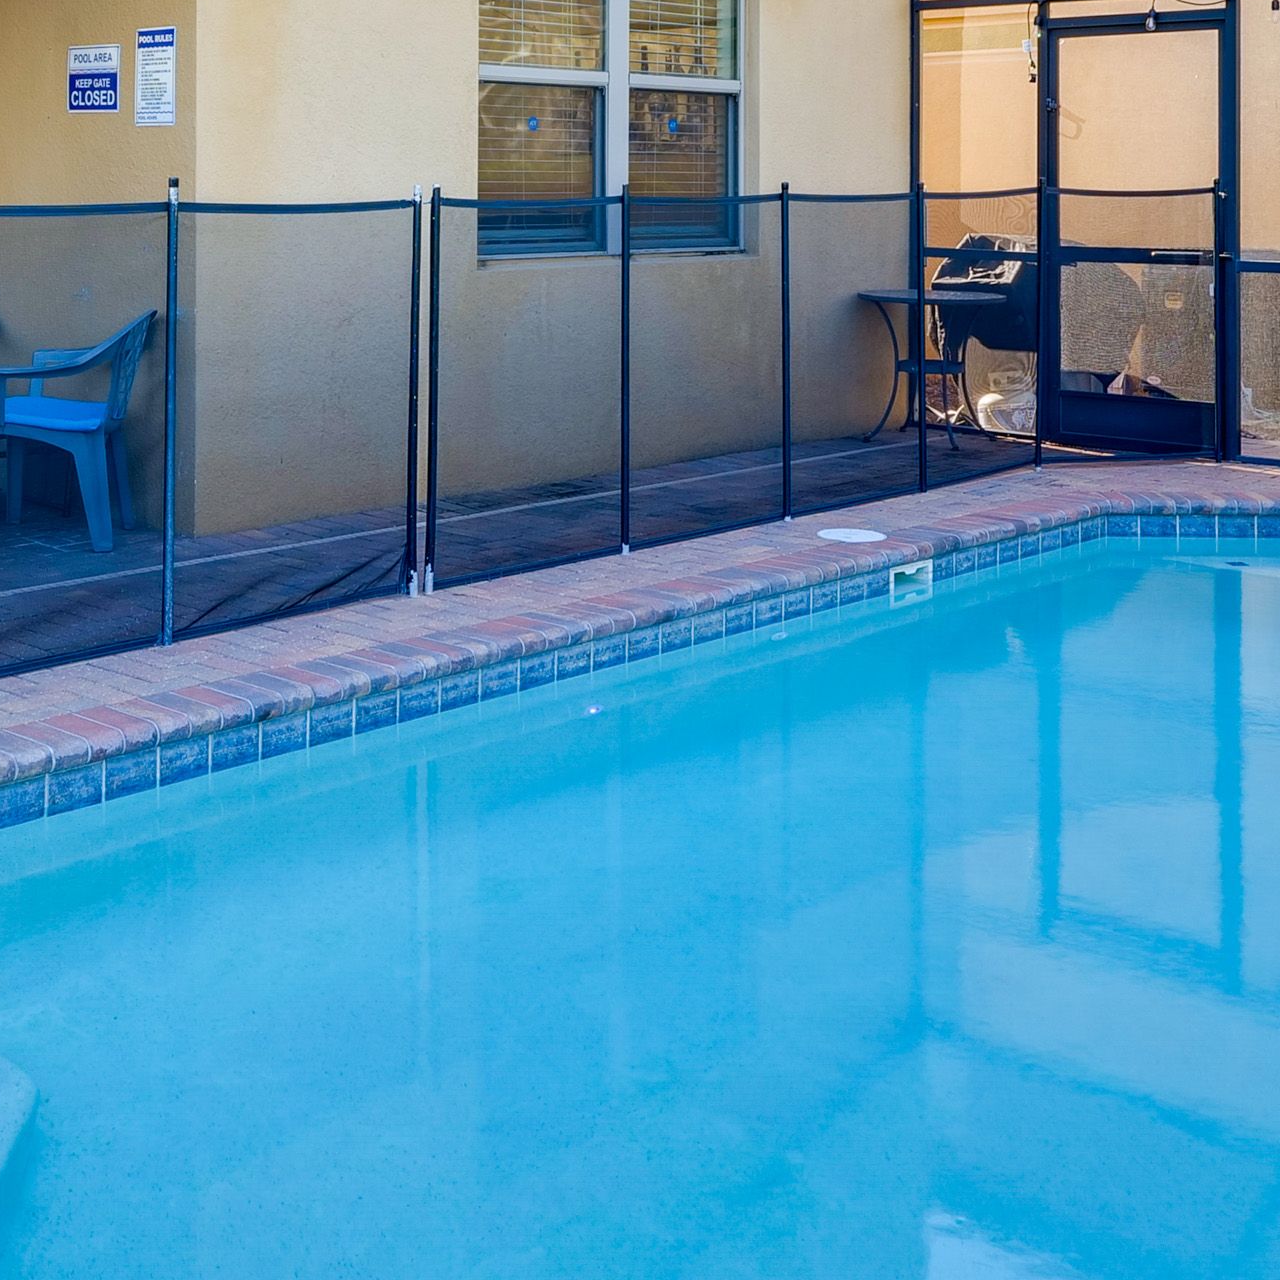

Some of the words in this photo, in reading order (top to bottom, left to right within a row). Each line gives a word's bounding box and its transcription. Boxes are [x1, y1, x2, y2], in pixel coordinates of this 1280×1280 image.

[138, 35, 154, 44] POOL
[155, 34, 173, 42] RULES
[73, 53, 92, 64] POOL
[93, 52, 113, 63] AREA
[75, 79, 92, 88] KEEP
[93, 78, 111, 88] GATE
[71, 90, 115, 106] CLOSED
